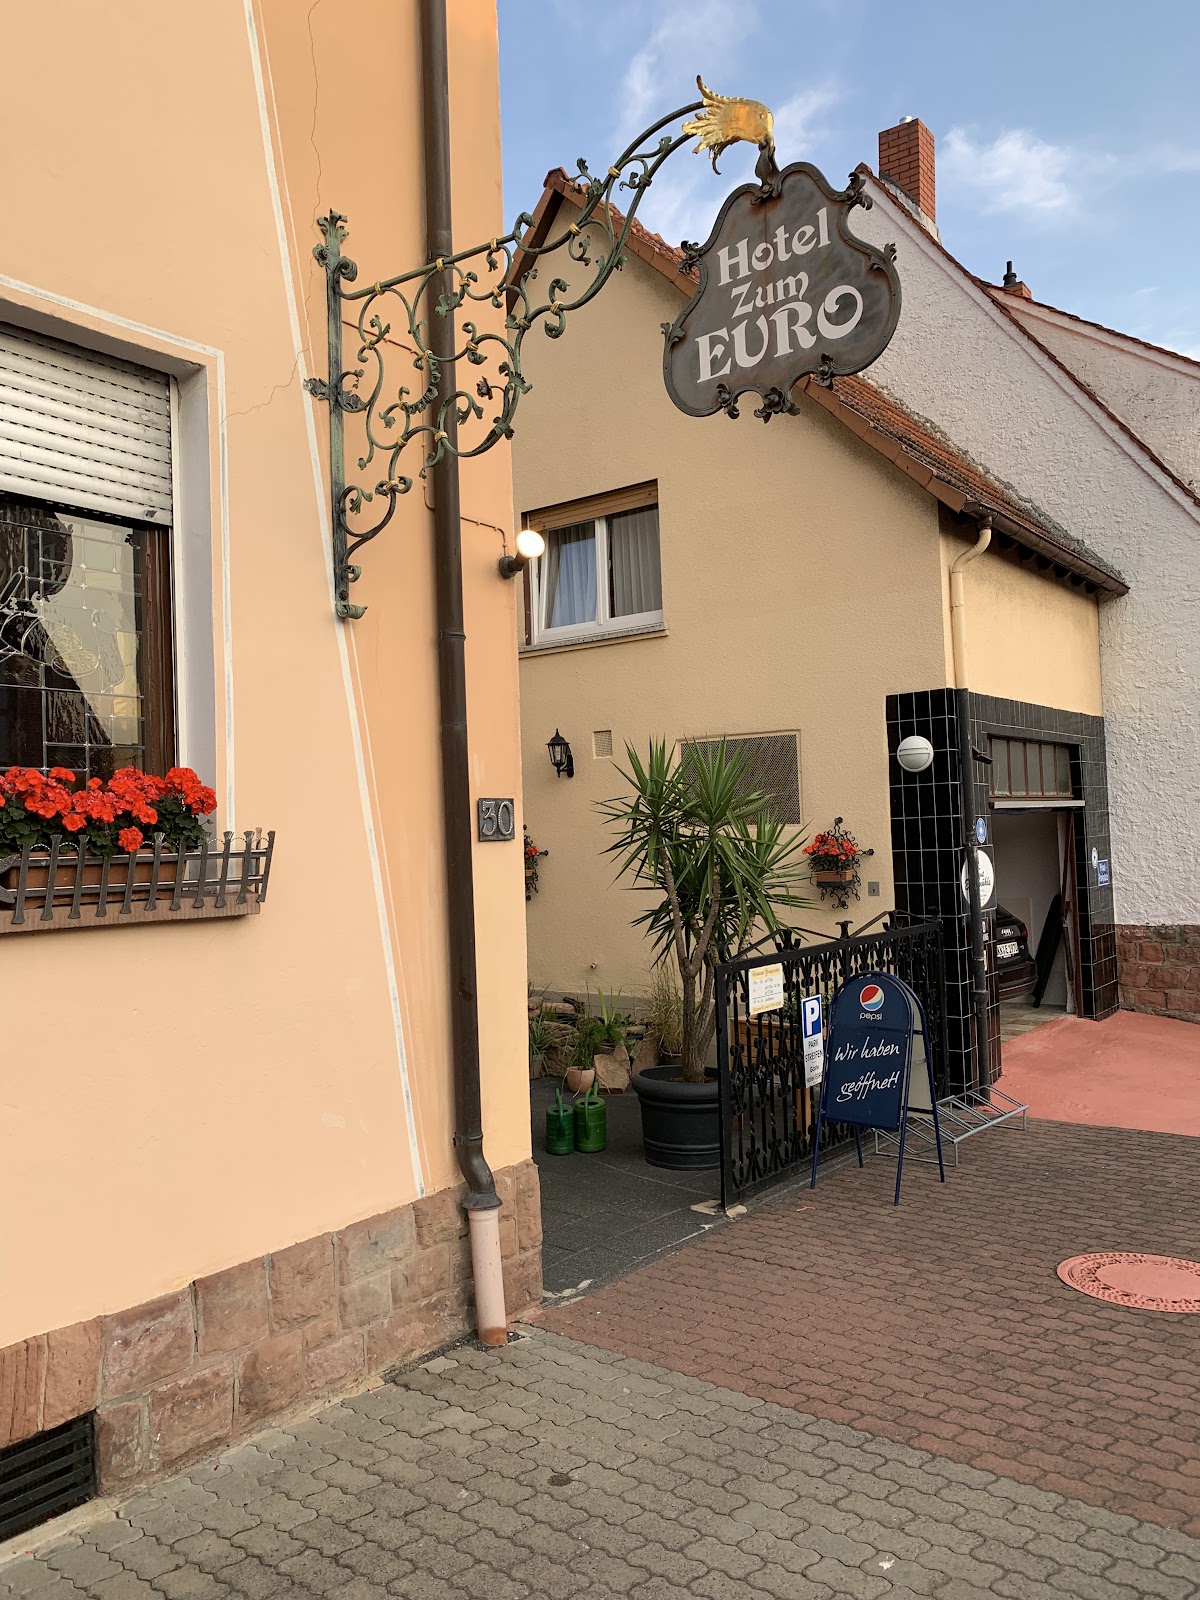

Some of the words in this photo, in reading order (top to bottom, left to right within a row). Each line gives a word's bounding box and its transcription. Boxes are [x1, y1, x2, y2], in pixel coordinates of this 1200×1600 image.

[717, 206, 831, 286] Hotel
[730, 271, 809, 319] Zum
[695, 285, 863, 383] EURO
[483, 801, 513, 835] 30
[805, 999, 820, 1037] P
[859, 1012, 883, 1021] pepsi
[805, 1049, 823, 1063] STREIFEN
[808, 1039, 819, 1049] PARK
[834, 1042, 858, 1062] Wir
[860, 1035, 900, 1059] haben
[836, 1070, 900, 1103] geöffnet!
